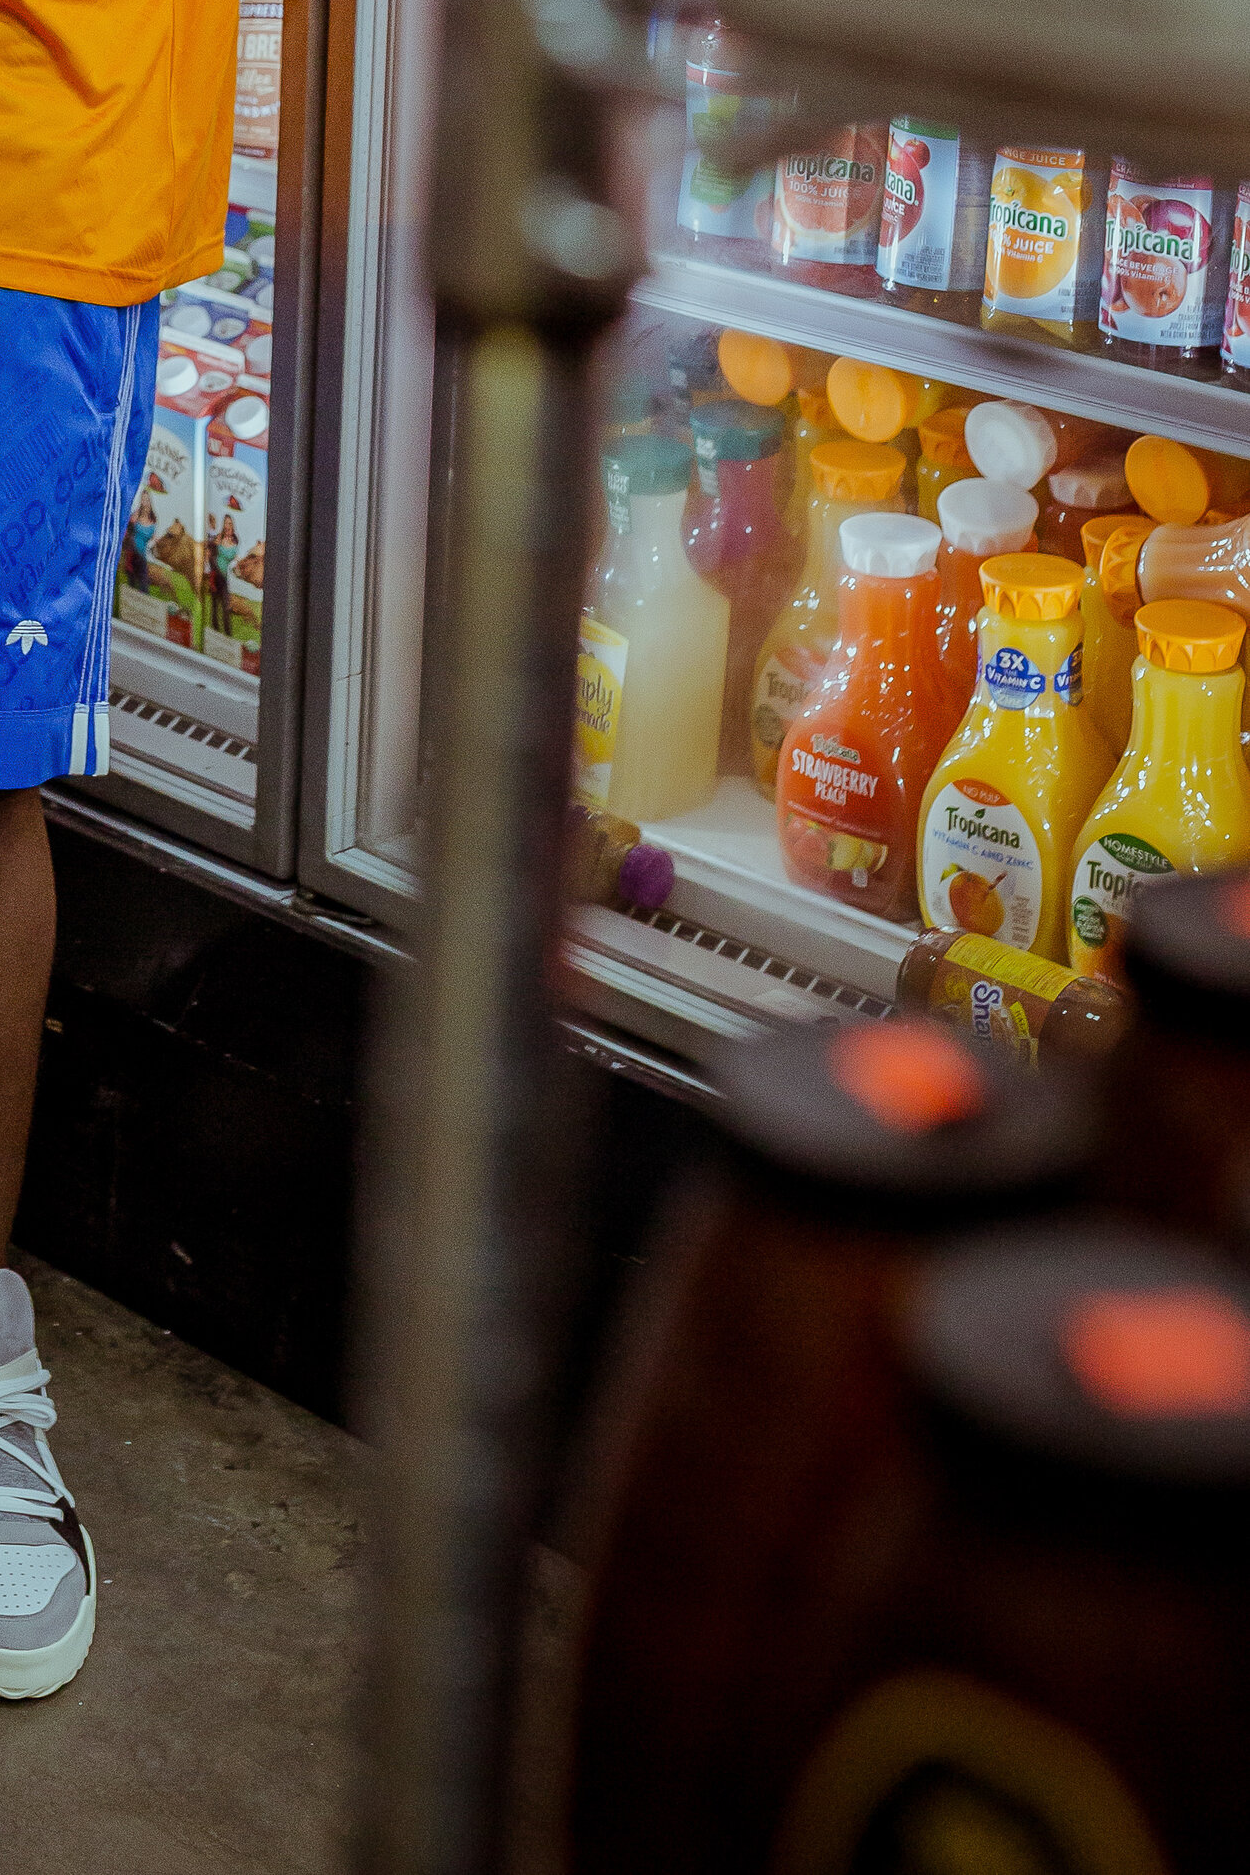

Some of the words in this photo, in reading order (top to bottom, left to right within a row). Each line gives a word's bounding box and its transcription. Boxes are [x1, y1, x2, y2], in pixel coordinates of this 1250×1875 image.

[786, 155, 875, 184] Tropicana
[1029, 153, 1066, 167] JUICE
[789, 181, 819, 196] 100%
[989, 197, 1067, 239] Tropicana
[1013, 237, 1055, 255] JUICE
[1105, 220, 1195, 261] Tropicana
[1129, 261, 1180, 276] BEVERAGE
[998, 651, 1025, 672] 3X
[987, 667, 1028, 688] VITAMIN
[1030, 677, 1042, 690] C
[792, 749, 879, 799] STRAWBERRY
[815, 781, 848, 806] PEACH
[945, 807, 1021, 849] Tropicana
[1104, 837, 1169, 868] HOMESTYLE
[1087, 861, 1144, 899] Tropic
[972, 982, 1001, 1043] Snap
